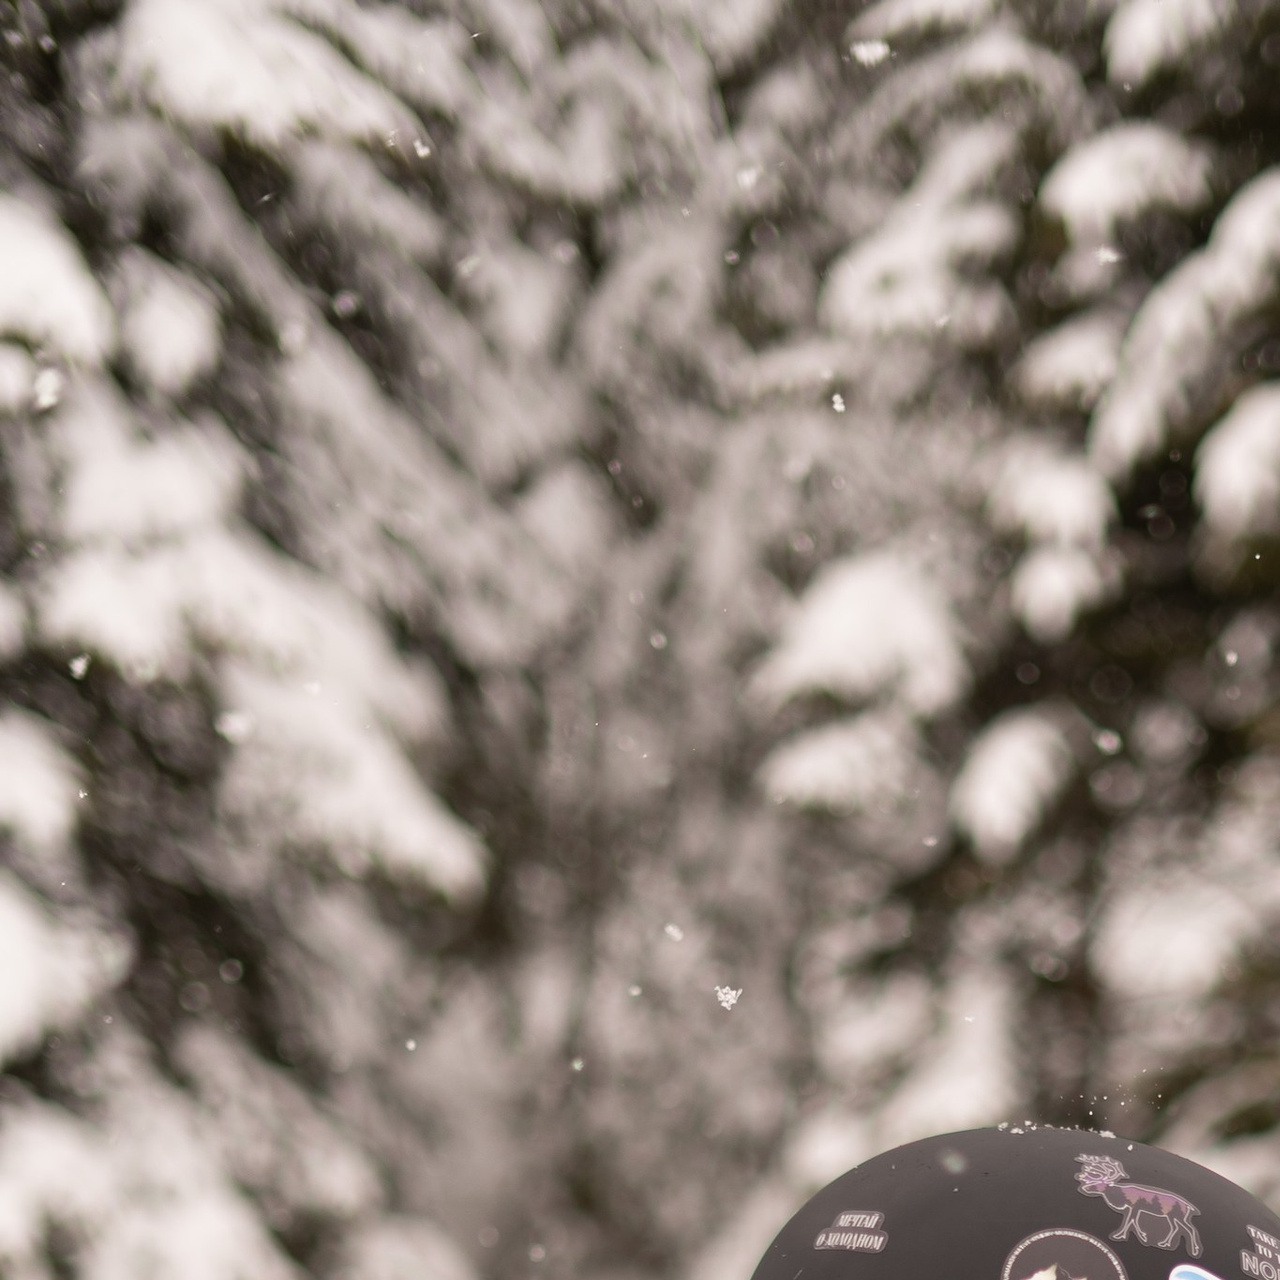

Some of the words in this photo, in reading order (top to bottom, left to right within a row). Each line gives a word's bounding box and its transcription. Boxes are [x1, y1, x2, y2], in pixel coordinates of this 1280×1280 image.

[836, 1213, 880, 1229] МЕЧТАЙ
[825, 1232, 884, 1250] ХОЛОДНОМ
[1248, 1226, 1278, 1250] TAKE
[1255, 1242, 1273, 1259] TO
